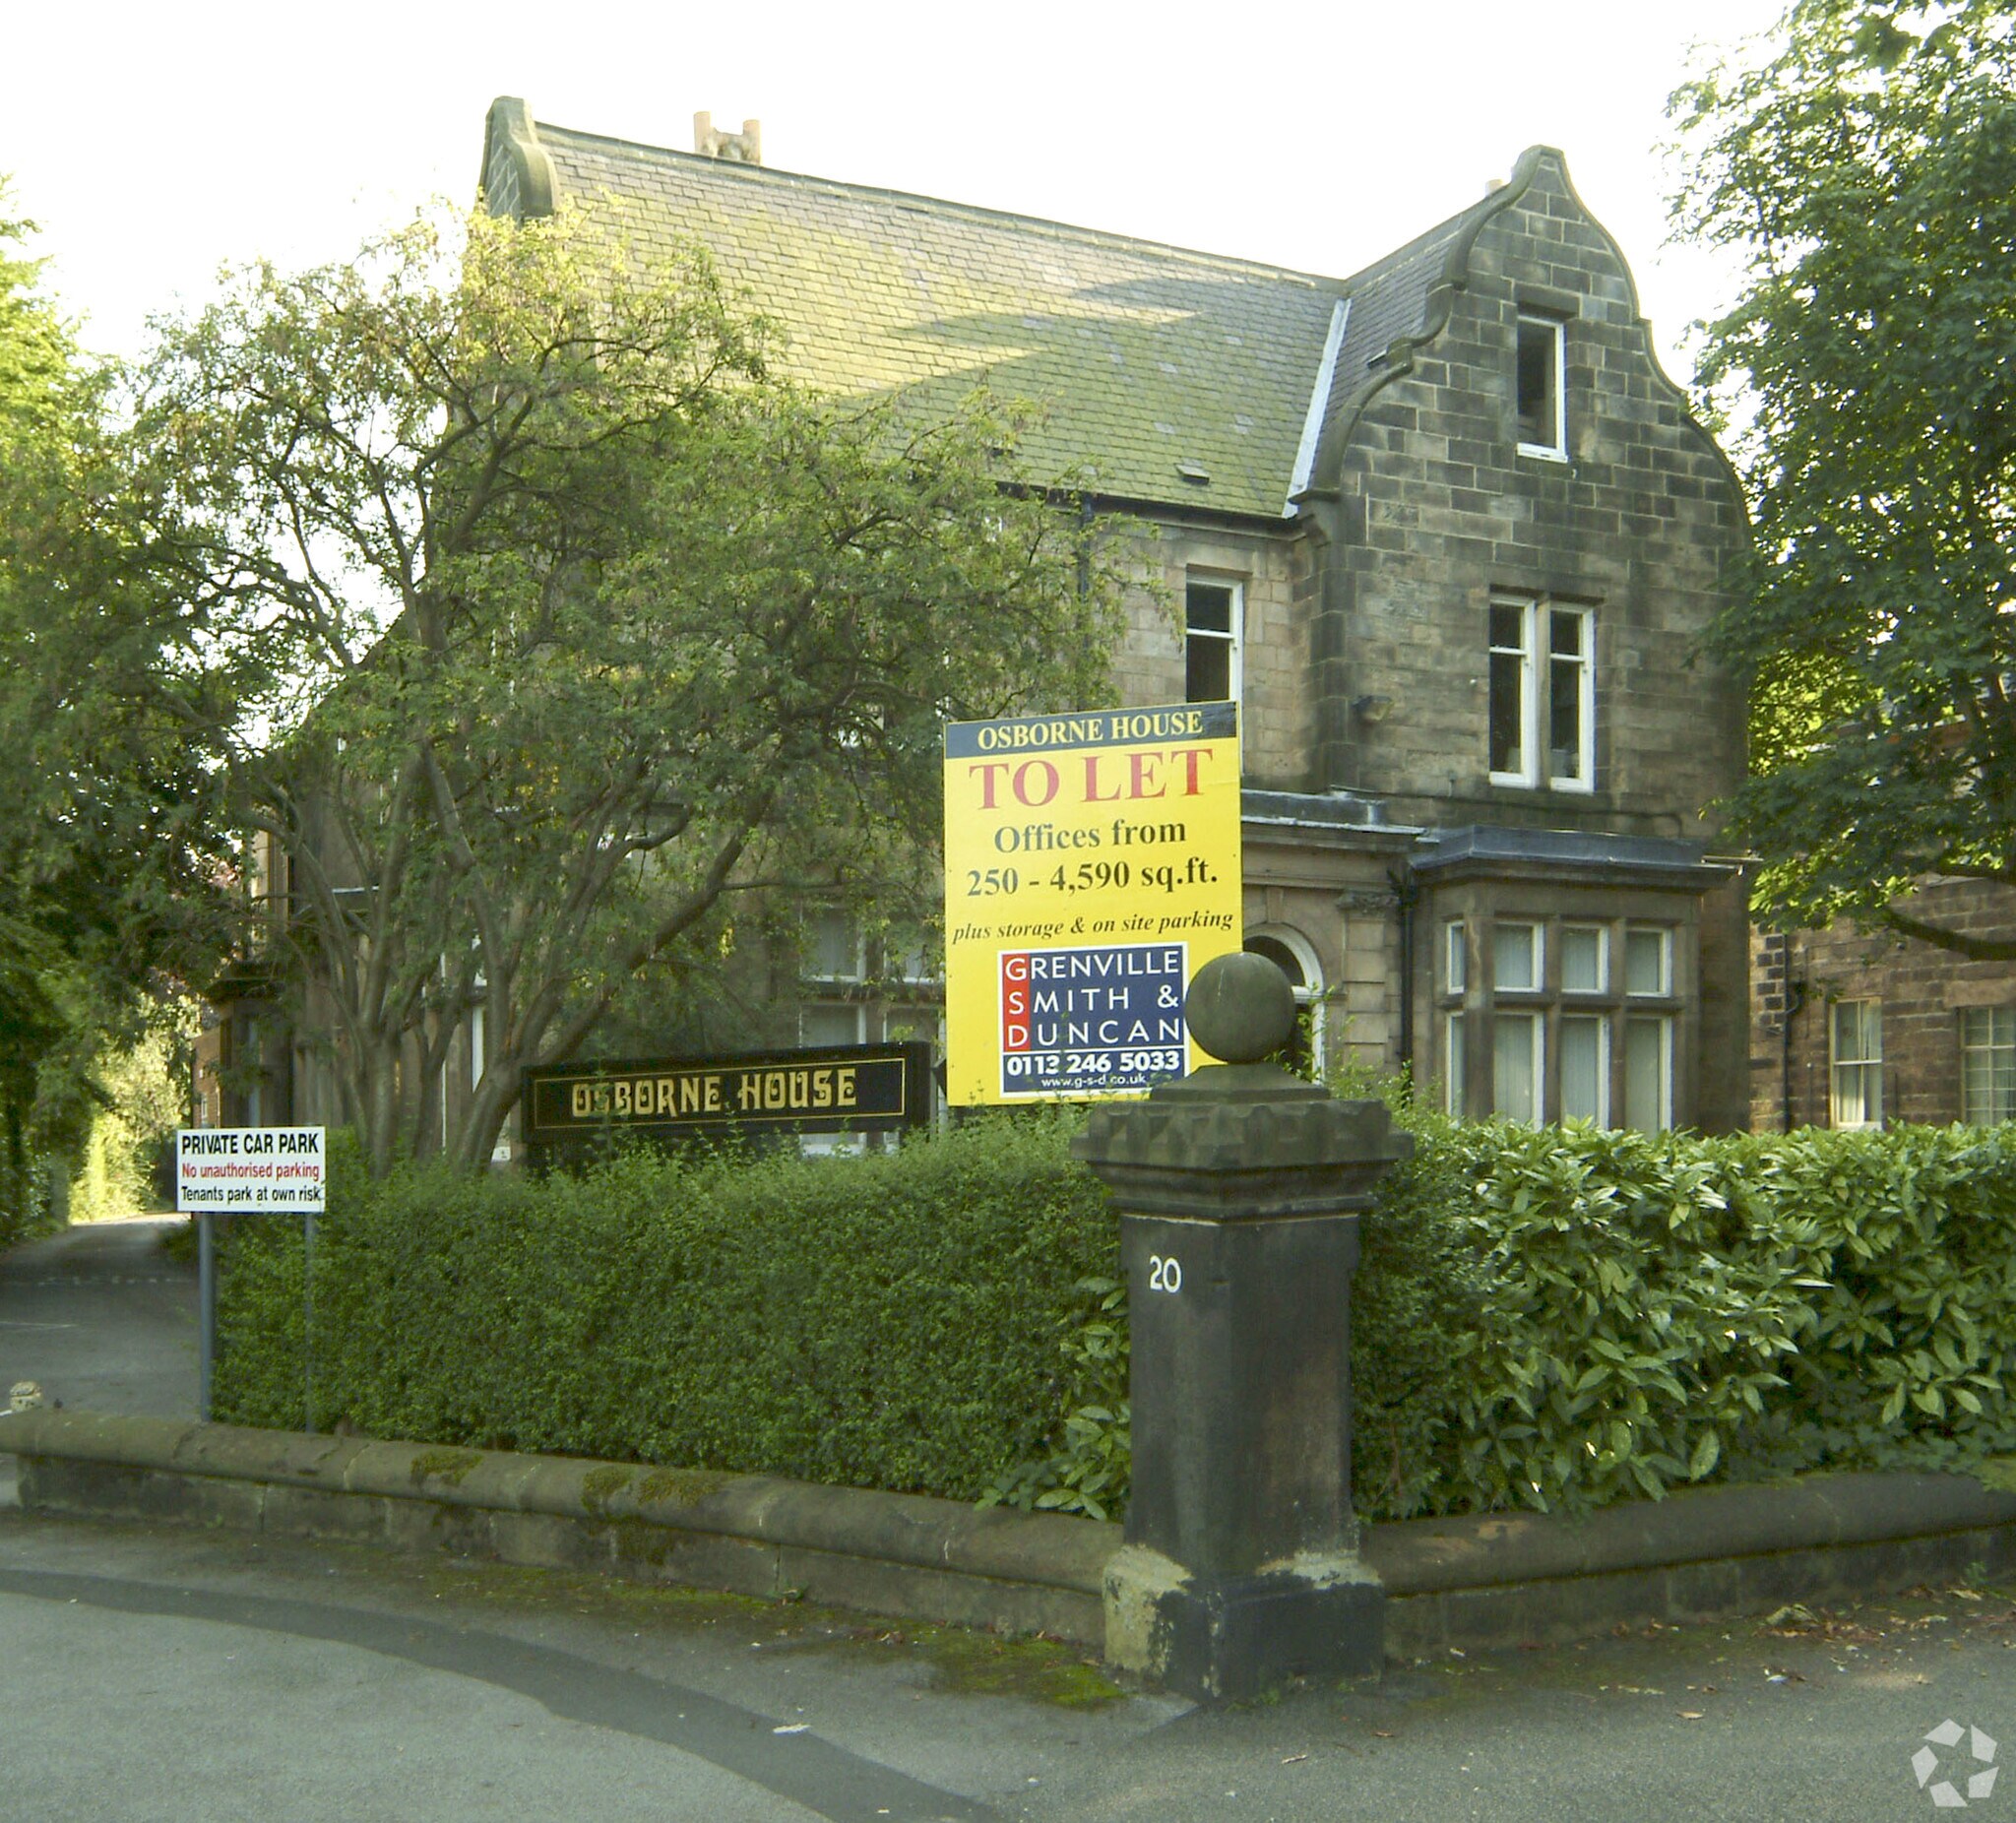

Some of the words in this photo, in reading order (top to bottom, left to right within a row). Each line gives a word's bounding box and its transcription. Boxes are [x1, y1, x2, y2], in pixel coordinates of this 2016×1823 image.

[977, 719, 1103, 750] OSBORNE
[1111, 711, 1203, 738] HOUSE
[969, 760, 1060, 810] TO
[1080, 748, 1214, 802] LET
[994, 823, 1101, 853] Offices
[1111, 819, 1187, 845] from
[967, 868, 1019, 897] 250
[1049, 861, 1130, 896] 4,590
[1141, 857, 1218, 893] sq.ft.
[953, 922, 991, 944] plus
[997, 918, 1064, 940] storage
[1070, 916, 1085, 933] &
[1093, 920, 1115, 932] on
[1122, 912, 1154, 931] site
[1159, 910, 1233, 935] parking
[1005, 951, 1179, 981] GRENVILLE
[1008, 987, 1130, 1015] SMITH
[1158, 984, 1179, 1008] &
[1008, 1018, 1180, 1047] DUNCAN
[1007, 1055, 1060, 1076] 0113
[1066, 1053, 1112, 1074] 246
[1119, 1050, 1180, 1072] 5033
[738, 1068, 857, 1110] HOUSE
[181, 1134, 238, 1155] PRIVATE
[243, 1133, 274, 1154] CAR
[279, 1133, 319, 1154] PARK
[182, 1163, 197, 1178] No
[200, 1163, 273, 1178] unauthorised
[276, 1162, 320, 1181] parking
[181, 1185, 223, 1201] Tenants
[227, 1185, 252, 1204] park
[256, 1186, 268, 1201] at
[272, 1189, 295, 1201] own
[298, 1184, 321, 1201] risk
[1150, 1255, 1182, 1293] 20
